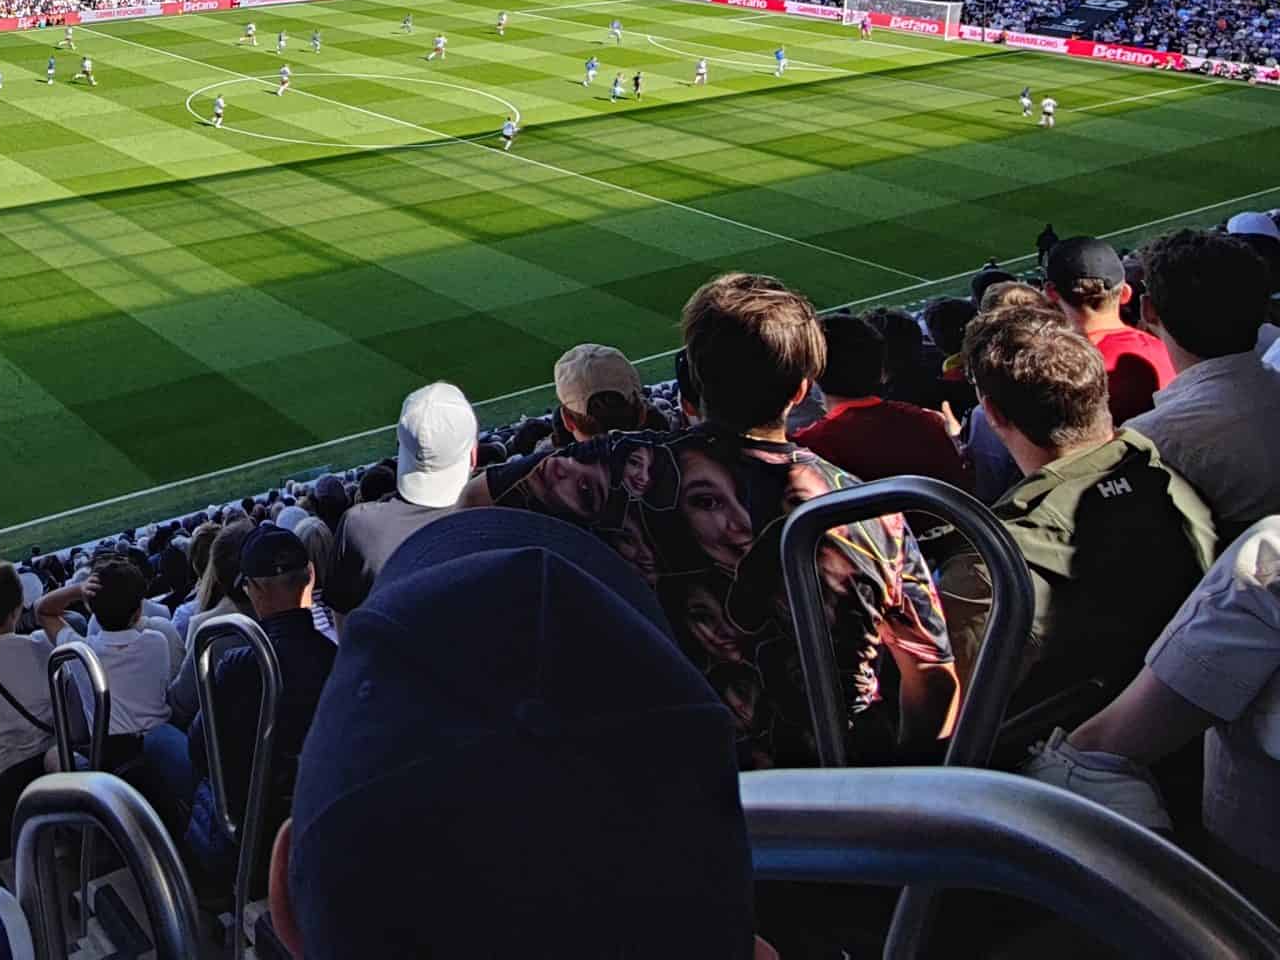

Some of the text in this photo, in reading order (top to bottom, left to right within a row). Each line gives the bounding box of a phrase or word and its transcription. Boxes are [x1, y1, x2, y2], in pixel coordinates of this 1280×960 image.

[889, 17, 938, 33] Betano
[1092, 44, 1154, 65] Betano
[1096, 477, 1133, 498] HH
